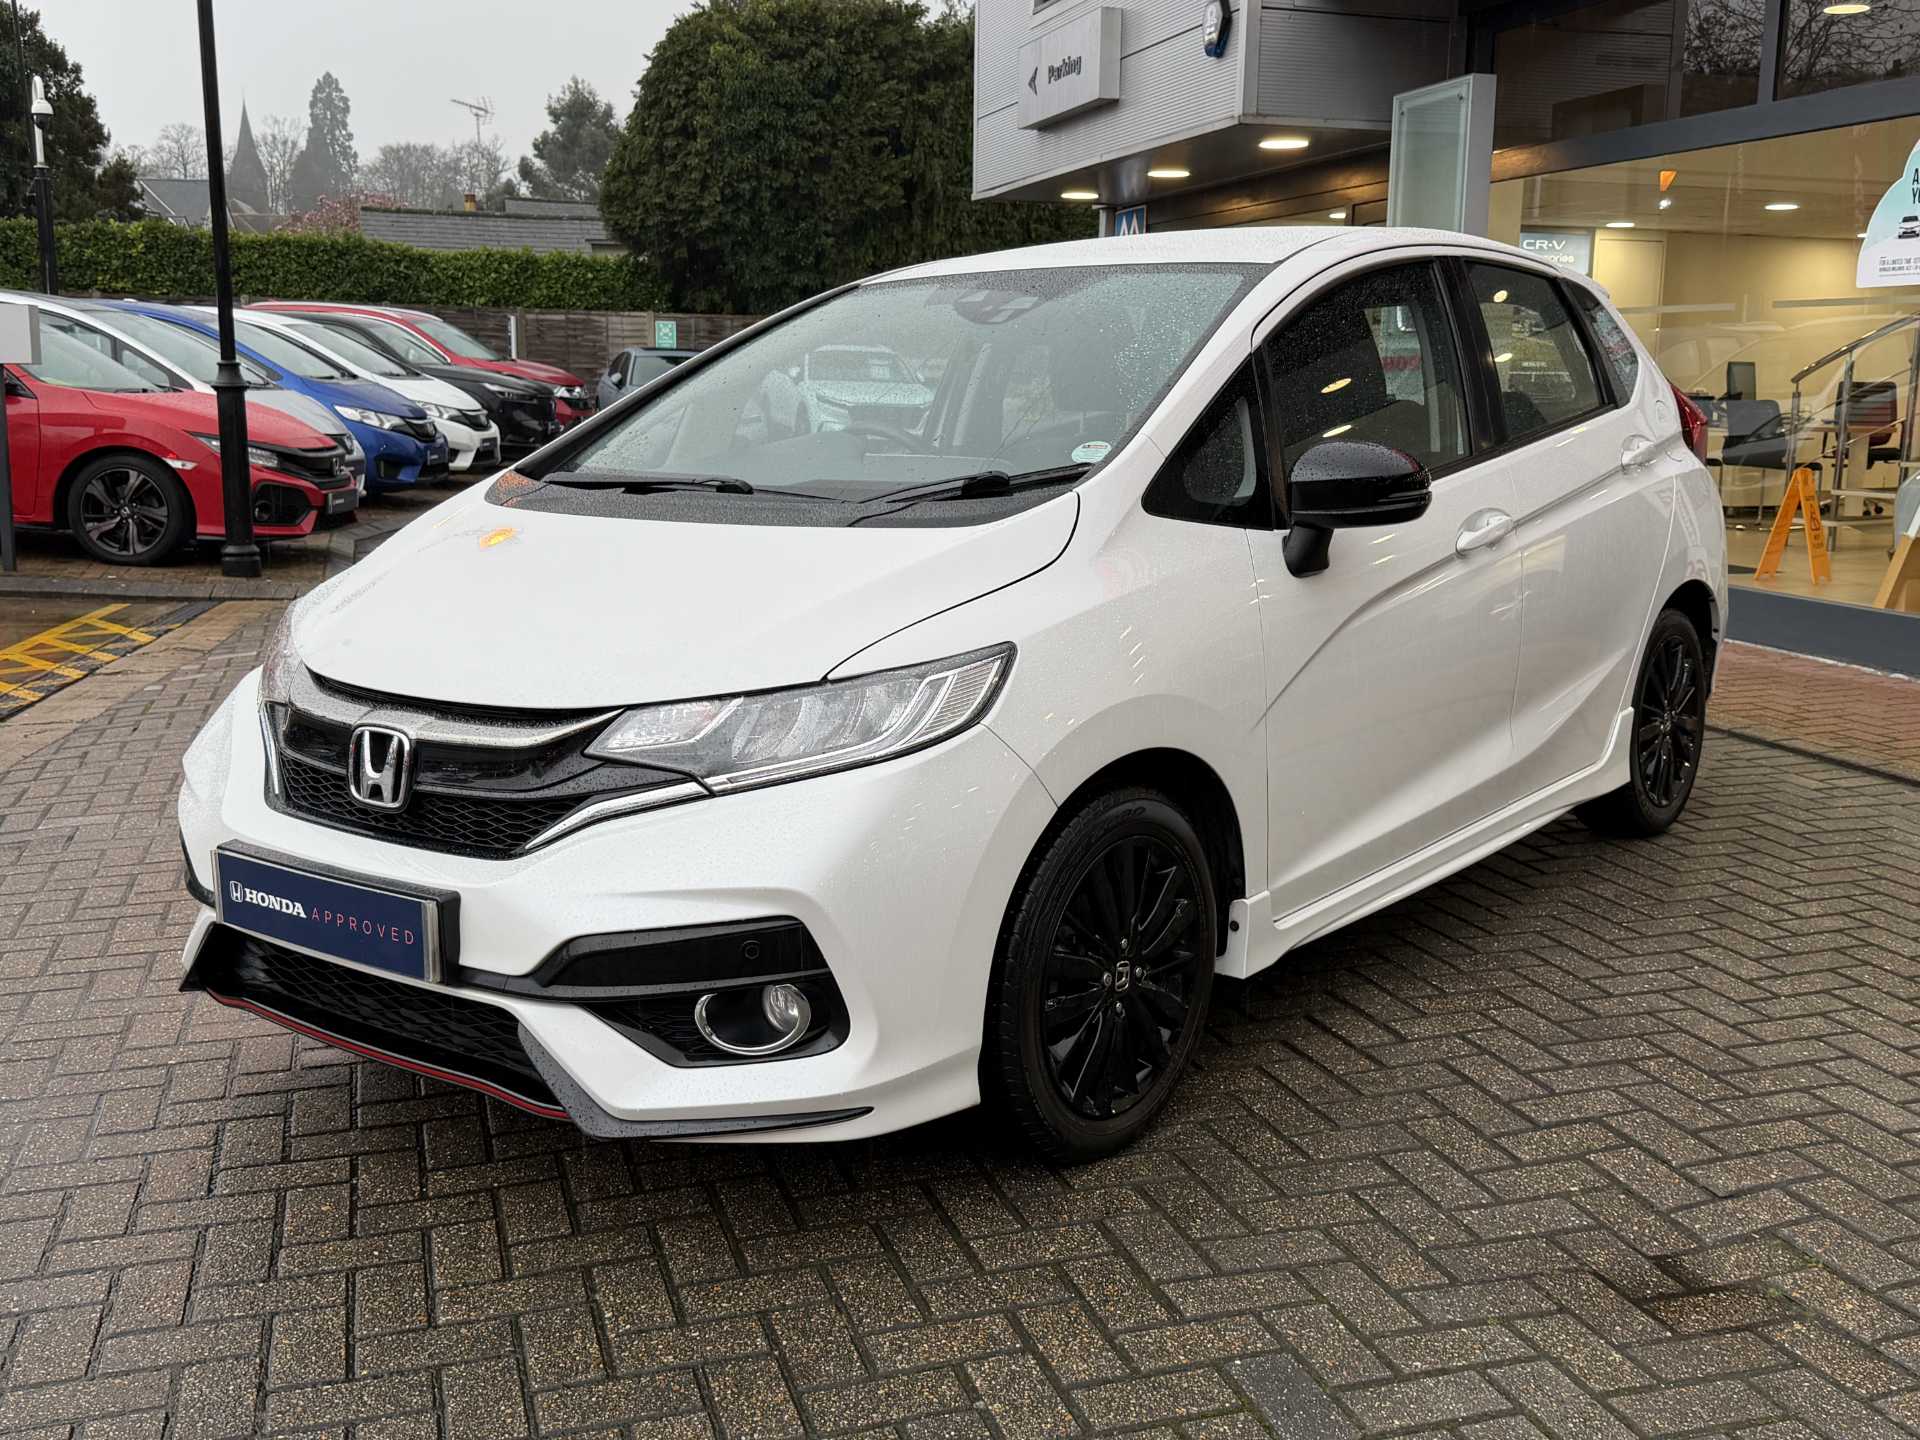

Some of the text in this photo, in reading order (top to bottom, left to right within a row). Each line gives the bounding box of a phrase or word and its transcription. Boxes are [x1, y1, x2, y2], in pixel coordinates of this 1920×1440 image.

[1048, 56, 1081, 84] Parking
[244, 887, 307, 918] HONDA
[312, 907, 414, 945] APPROVED
